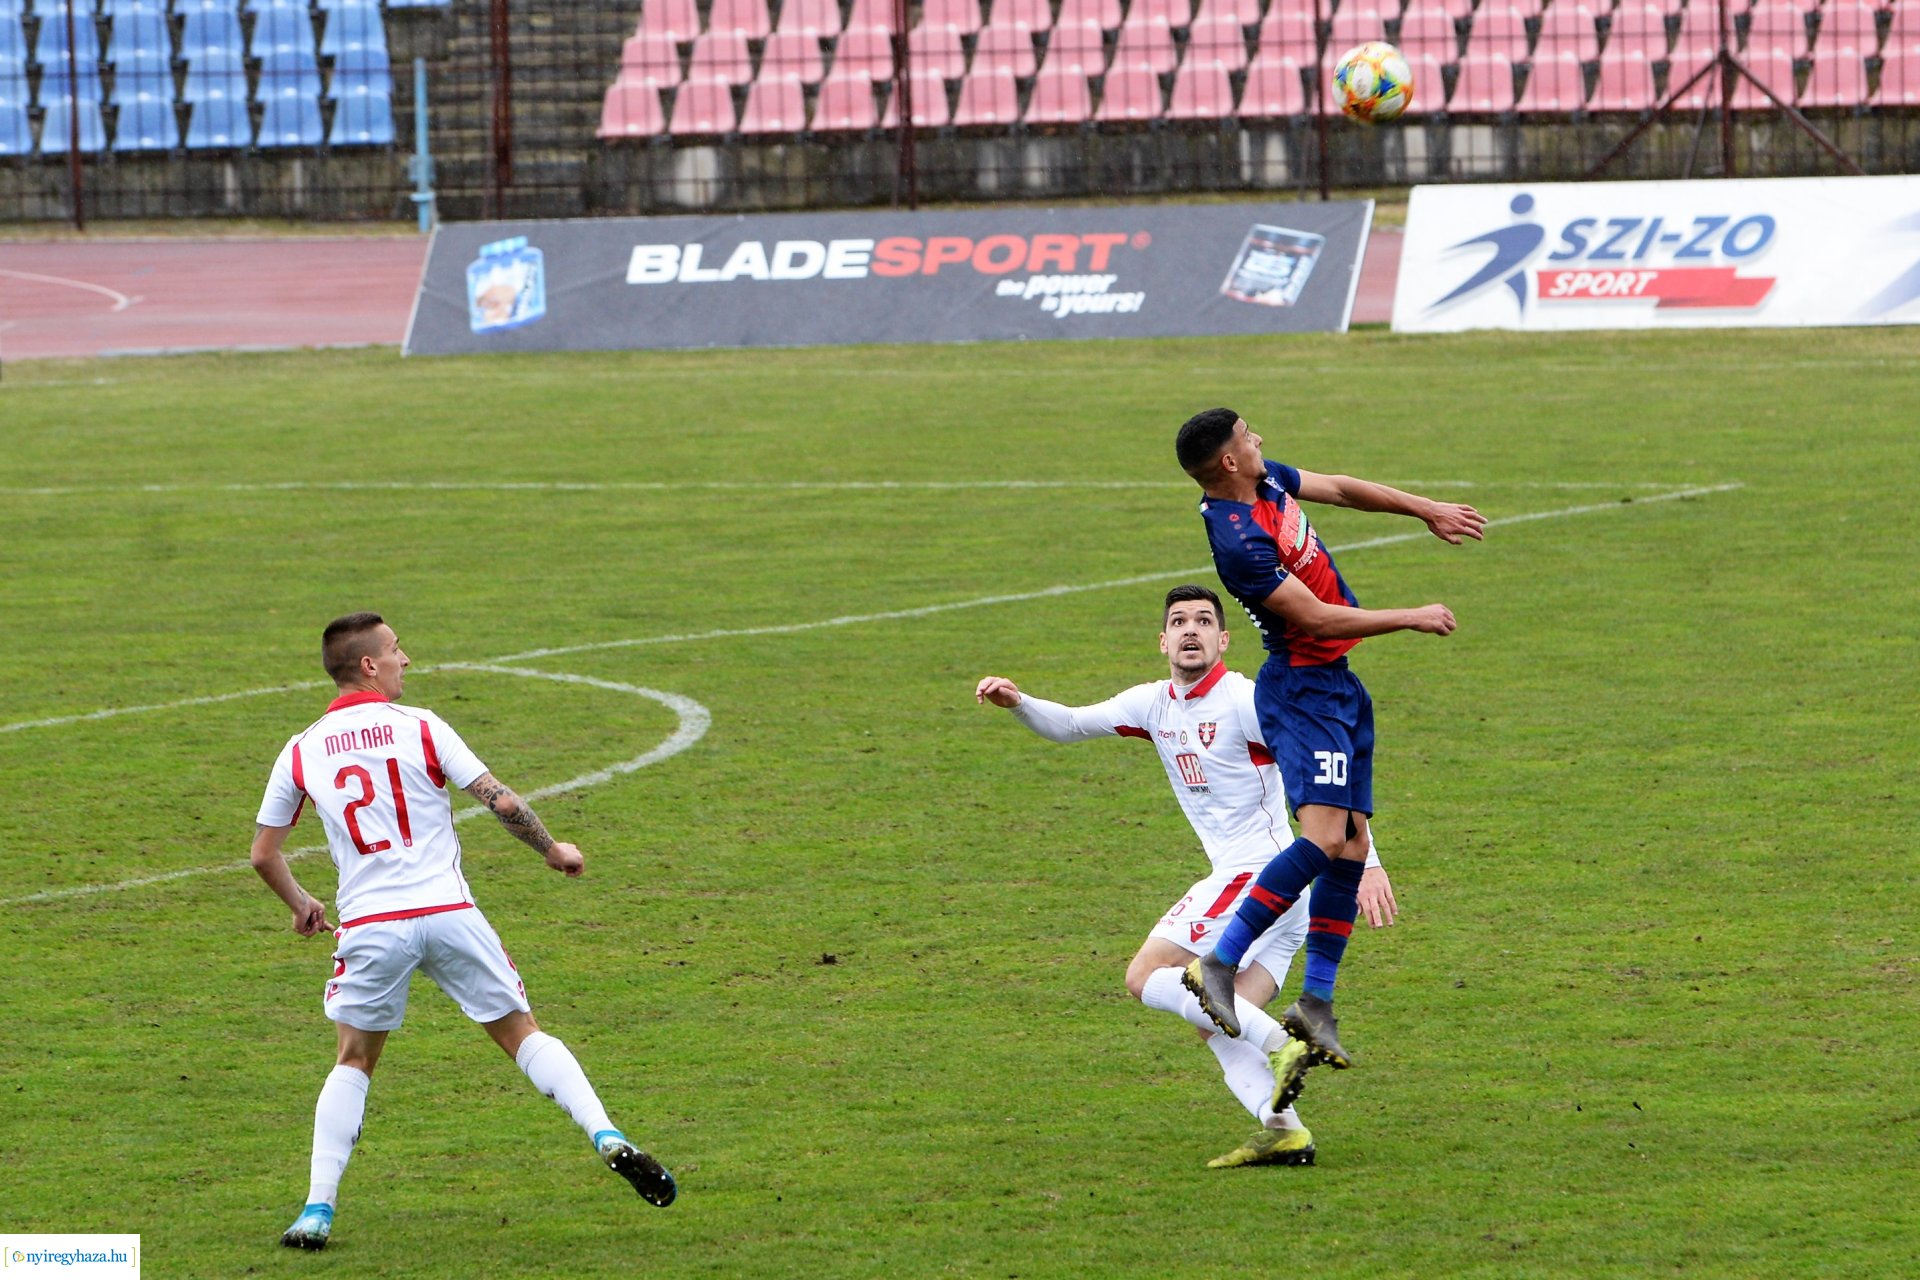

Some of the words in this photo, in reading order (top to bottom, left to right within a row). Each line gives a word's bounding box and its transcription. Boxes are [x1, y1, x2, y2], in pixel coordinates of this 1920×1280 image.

[1548, 213, 1776, 262] SZI-ZO
[626, 234, 1126, 284] BLADESPORT
[1022, 274, 1118, 301] power
[1548, 271, 1658, 298] SPORT
[1053, 291, 1146, 319] yours!
[324, 721, 396, 757] MOLNÁR
[1313, 750, 1348, 787] 30
[333, 757, 414, 856] 21
[1170, 896, 1193, 917] 6
